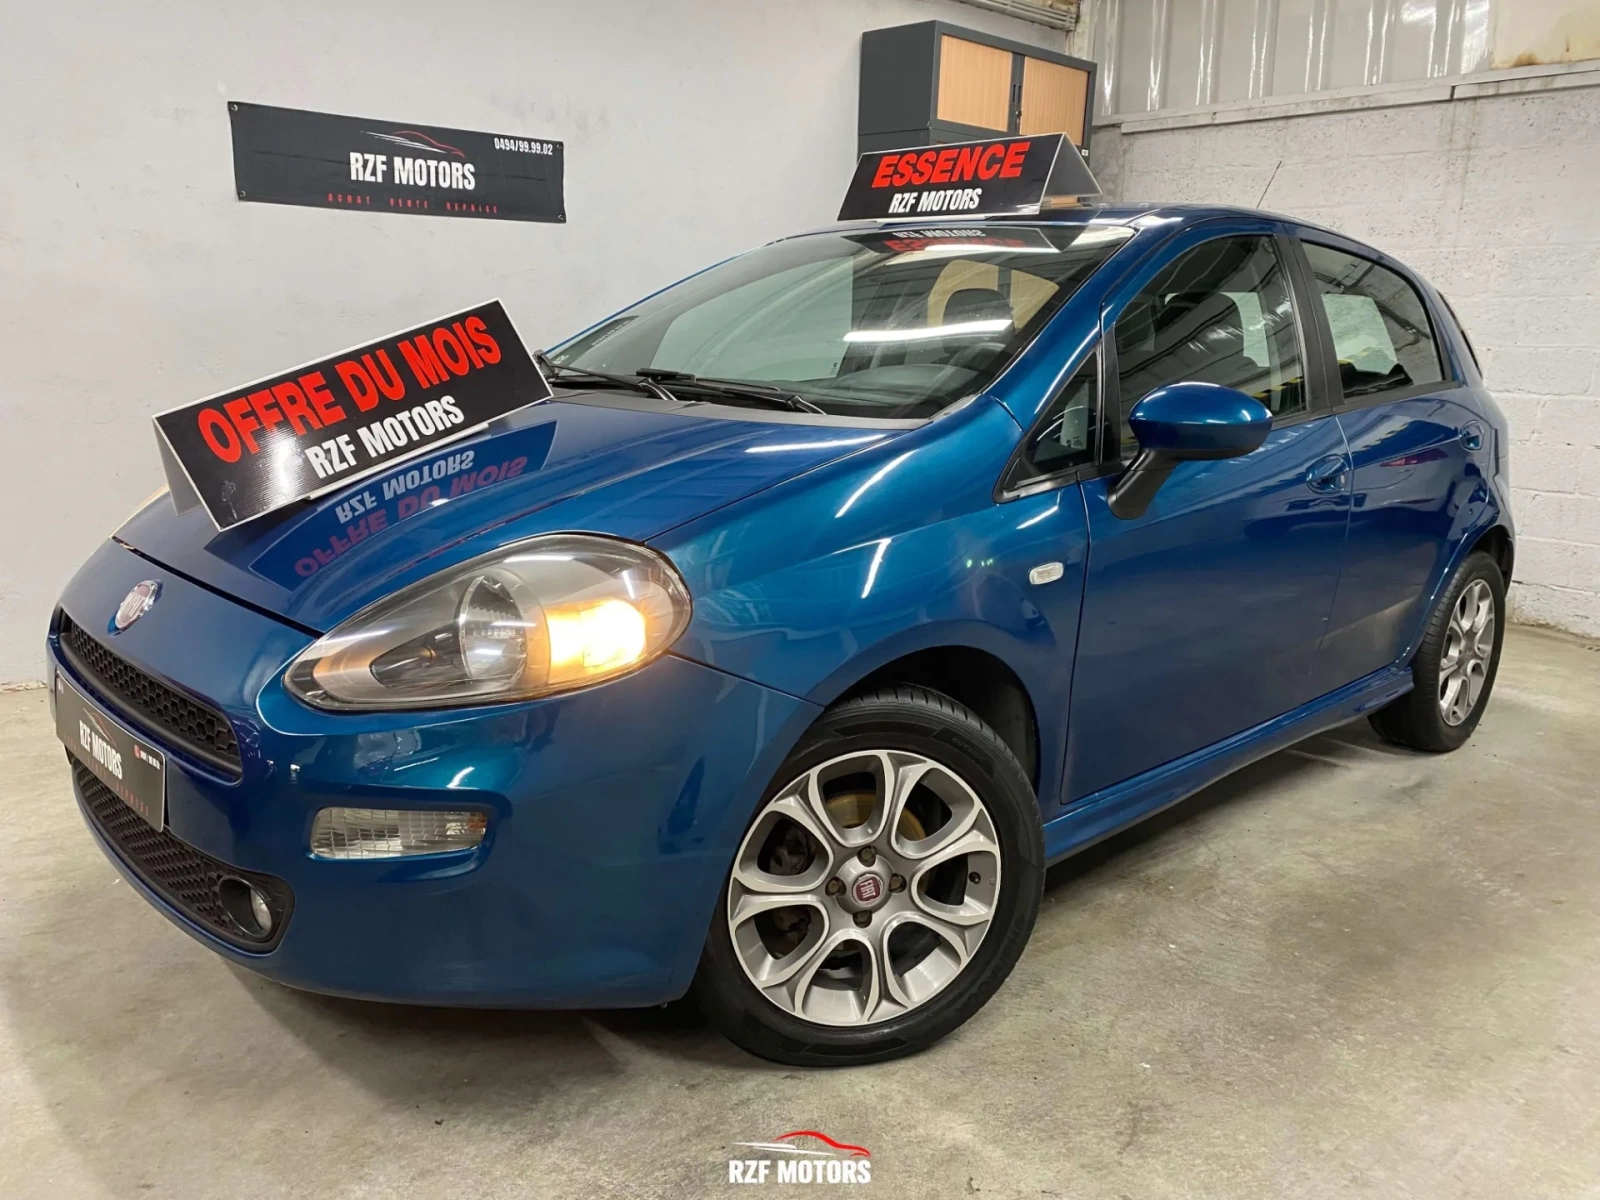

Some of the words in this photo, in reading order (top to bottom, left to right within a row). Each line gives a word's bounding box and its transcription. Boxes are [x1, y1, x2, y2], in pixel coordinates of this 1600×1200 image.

[493, 137, 553, 156] 0494/99.99.02
[871, 141, 1031, 189] ESSENCE
[349, 152, 388, 183] RZF
[393, 156, 476, 190] MOTORS
[888, 191, 918, 213] RZF
[917, 187, 983, 213] MOTORS
[197, 371, 346, 463] OFFRE
[335, 349, 406, 412] DU
[397, 315, 501, 389] MOIS
[304, 433, 358, 479] RZF
[357, 395, 465, 458] MOTORS
[91, 731, 123, 780] MOTORS
[859, 879, 877, 899] FIAT
